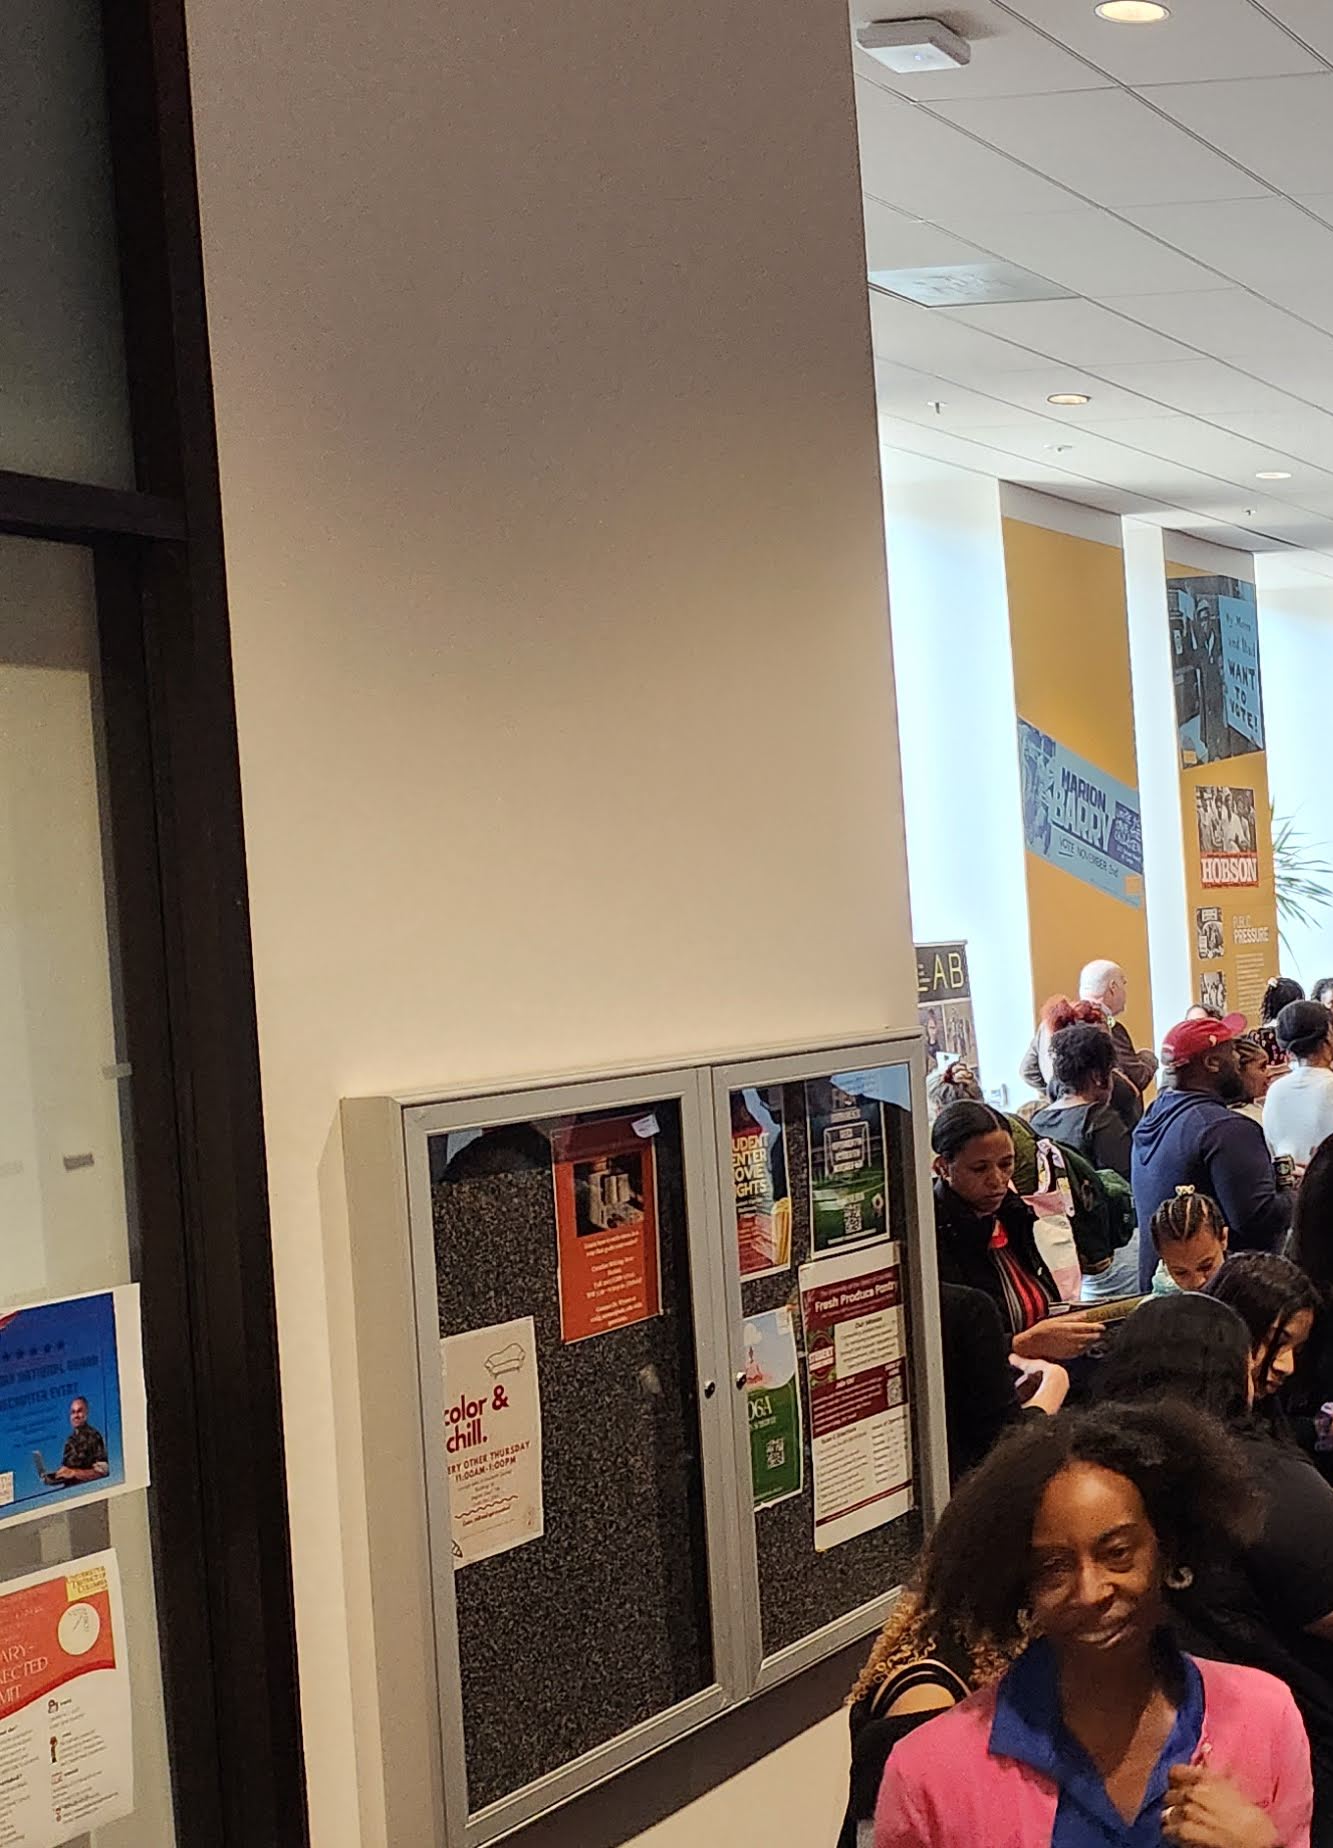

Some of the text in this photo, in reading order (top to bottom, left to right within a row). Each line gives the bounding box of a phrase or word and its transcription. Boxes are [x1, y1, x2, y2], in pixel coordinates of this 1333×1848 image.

[1227, 658, 1256, 692] WANT
[1233, 686, 1247, 706] TO
[1229, 703, 1258, 734] VOTE!
[1060, 767, 1107, 813] MARION
[1052, 788, 1110, 852] BARRY
[1200, 857, 1258, 884] HOBSON
[815, 1296, 839, 1313] Fresh
[492, 1384, 510, 1411] &
[446, 1418, 488, 1454] chill.
[463, 1453, 488, 1471] OTHER
[490, 1440, 531, 1461] THURSDAY
